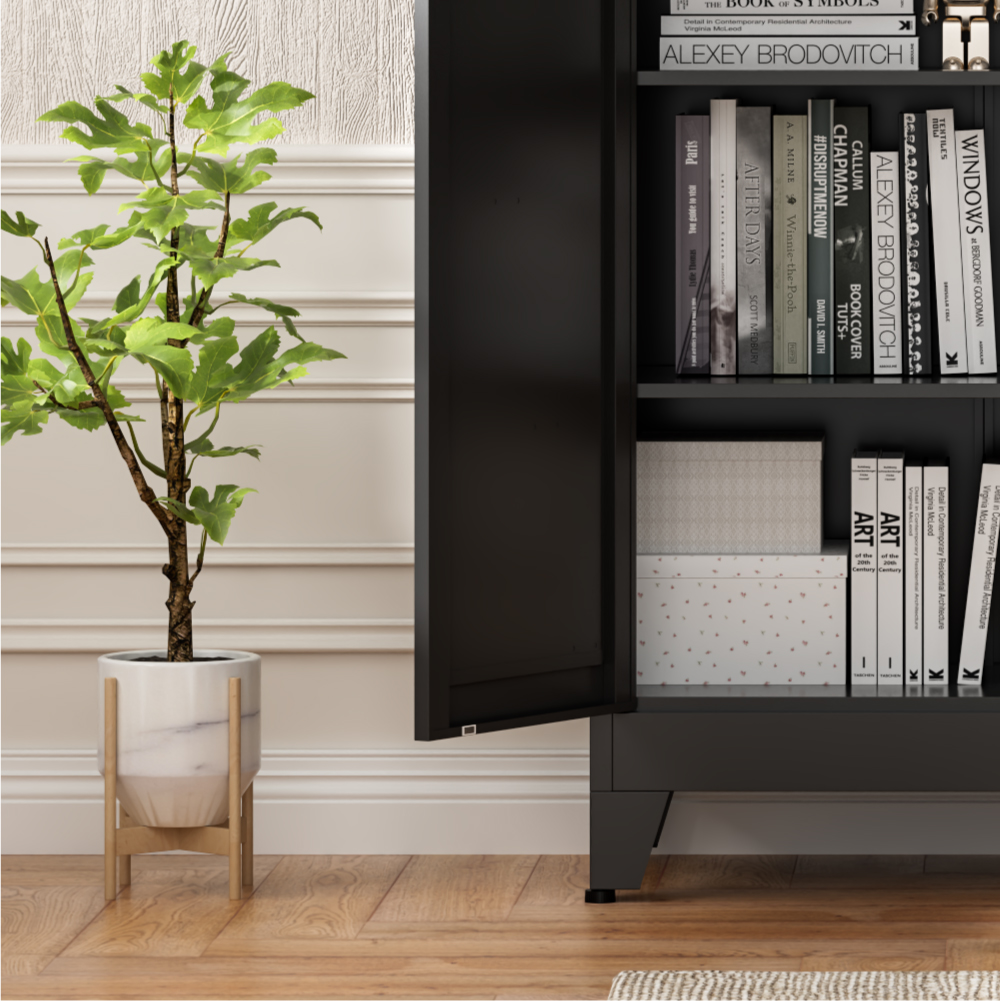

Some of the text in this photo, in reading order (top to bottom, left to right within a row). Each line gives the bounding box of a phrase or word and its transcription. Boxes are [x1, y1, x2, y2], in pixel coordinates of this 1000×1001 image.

[779, 0, 790, 8] OF
[663, 45, 750, 64] ALEXEY
[758, 44, 902, 65] BRODOVITCH
[685, 140, 698, 165] Paris
[786, 121, 795, 183] A. A. MILNE
[939, 118, 948, 160] TEXTILES
[833, 124, 848, 207] CHAPMAN
[852, 140, 863, 191] CALLUM
[961, 134, 984, 235] WINDOWS
[688, 184, 697, 197] visit
[813, 135, 827, 239] #DISRUPTMENOW
[876, 155, 894, 229] ALEXEY
[688, 205, 698, 222] guide
[745, 162, 762, 265] AFTER DAYS
[688, 249, 696, 270] Thomas
[786, 215, 796, 314] Winnie-the-Pooh
[971, 244, 983, 283] BERGDORF
[817, 299, 826, 322] DAVID
[878, 235, 896, 360] BRODOVITCH
[973, 284, 984, 327] GOODMAN
[749, 295, 758, 365] SCOTT MEDBURY
[837, 302, 849, 341] TUTS+
[850, 284, 862, 360] BOOK COVER
[817, 330, 826, 354] SMITH
[927, 487, 935, 510] Virginia
[938, 487, 946, 505] Detail
[977, 485, 991, 534] Virginia McLeod
[854, 511, 874, 547] ART
[880, 511, 900, 547] ART
[937, 513, 946, 556] Contemporary
[986, 512, 1000, 555] Contemporary
[938, 558, 946, 592] Residential
[984, 557, 995, 591] Residential
[938, 593, 946, 630] Architecture
[979, 592, 991, 629] Architecture
